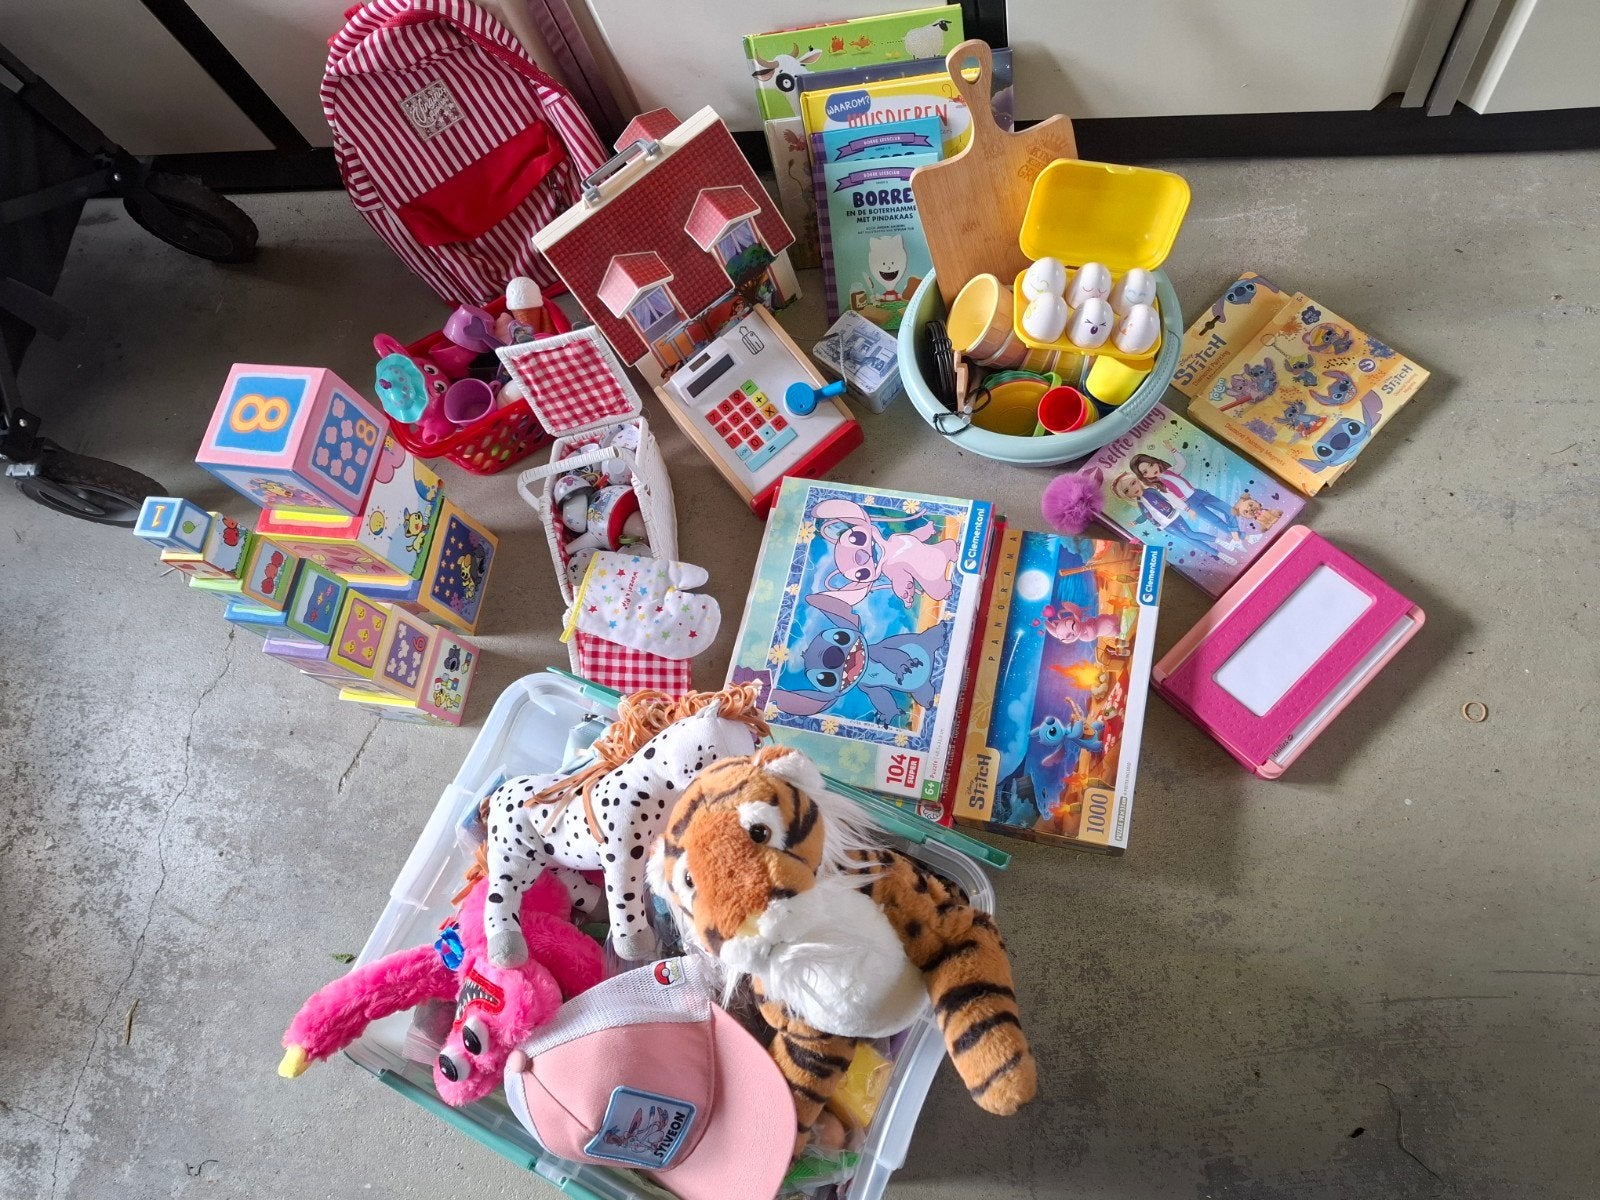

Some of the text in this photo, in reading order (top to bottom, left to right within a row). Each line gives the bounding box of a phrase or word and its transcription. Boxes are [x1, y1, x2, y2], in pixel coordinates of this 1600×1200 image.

[827, 95, 870, 116] WAAROM?
[852, 187, 914, 208] BORRE
[868, 205, 917, 215] BOTERHAMME
[872, 212, 914, 222] PINDAKAAS
[1098, 407, 1166, 469] Selfie Diary
[967, 507, 985, 558] Clementoni
[1145, 550, 1158, 593] Clementoni
[988, 536, 1018, 662] PANORAMA
[886, 753, 907, 784] 104
[907, 760, 919, 785] SUPER
[924, 782, 935, 796] 6+
[1087, 793, 1109, 834] 1000
[653, 1111, 685, 1158] SYLVEON
